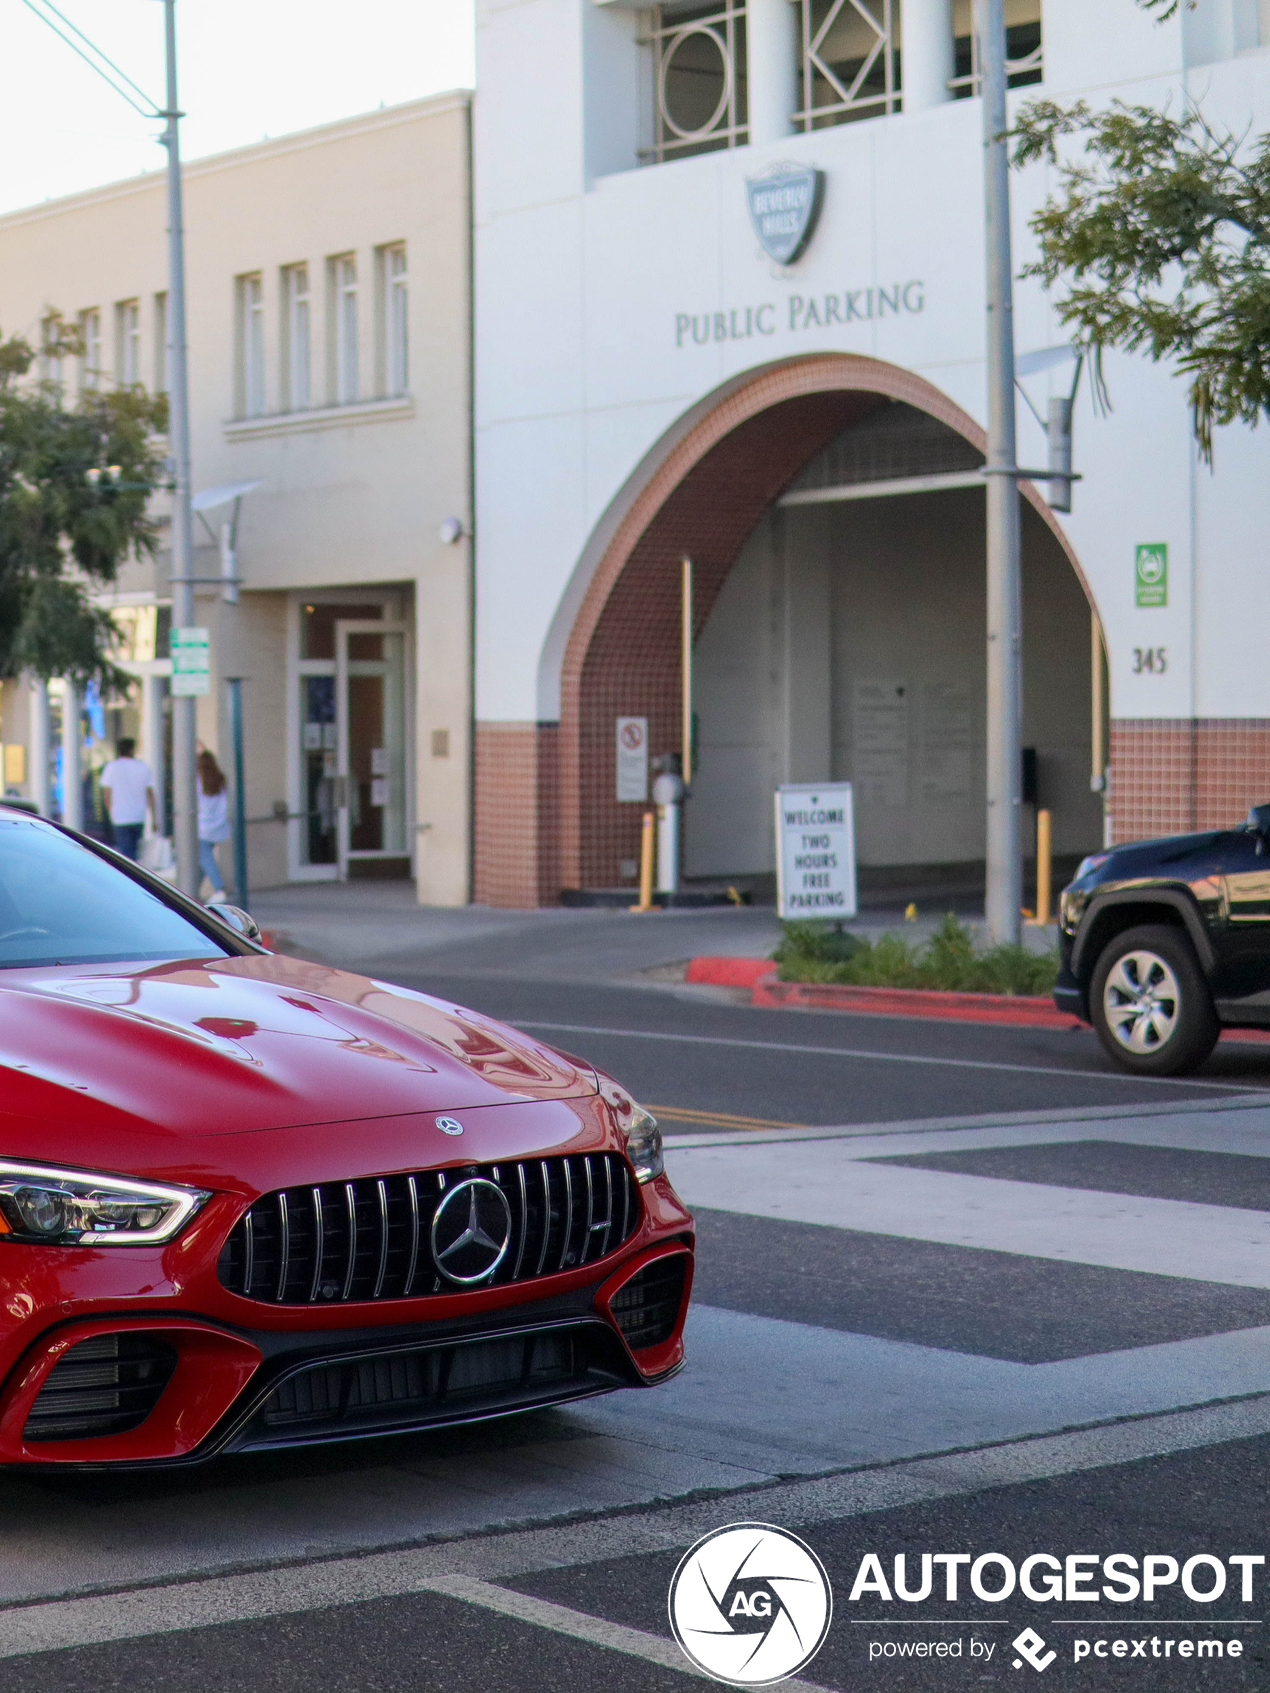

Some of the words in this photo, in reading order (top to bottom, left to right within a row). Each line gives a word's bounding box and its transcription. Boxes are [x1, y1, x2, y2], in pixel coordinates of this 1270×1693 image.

[675, 303, 776, 347] PUBLIC
[789, 279, 926, 331] PARKING
[1132, 646, 1166, 673] 345
[785, 808, 844, 826] WELCOME
[802, 833, 831, 849] TWO
[795, 852, 837, 869] HOURS
[803, 872, 831, 888] FREE
[790, 891, 844, 908] PARKING
